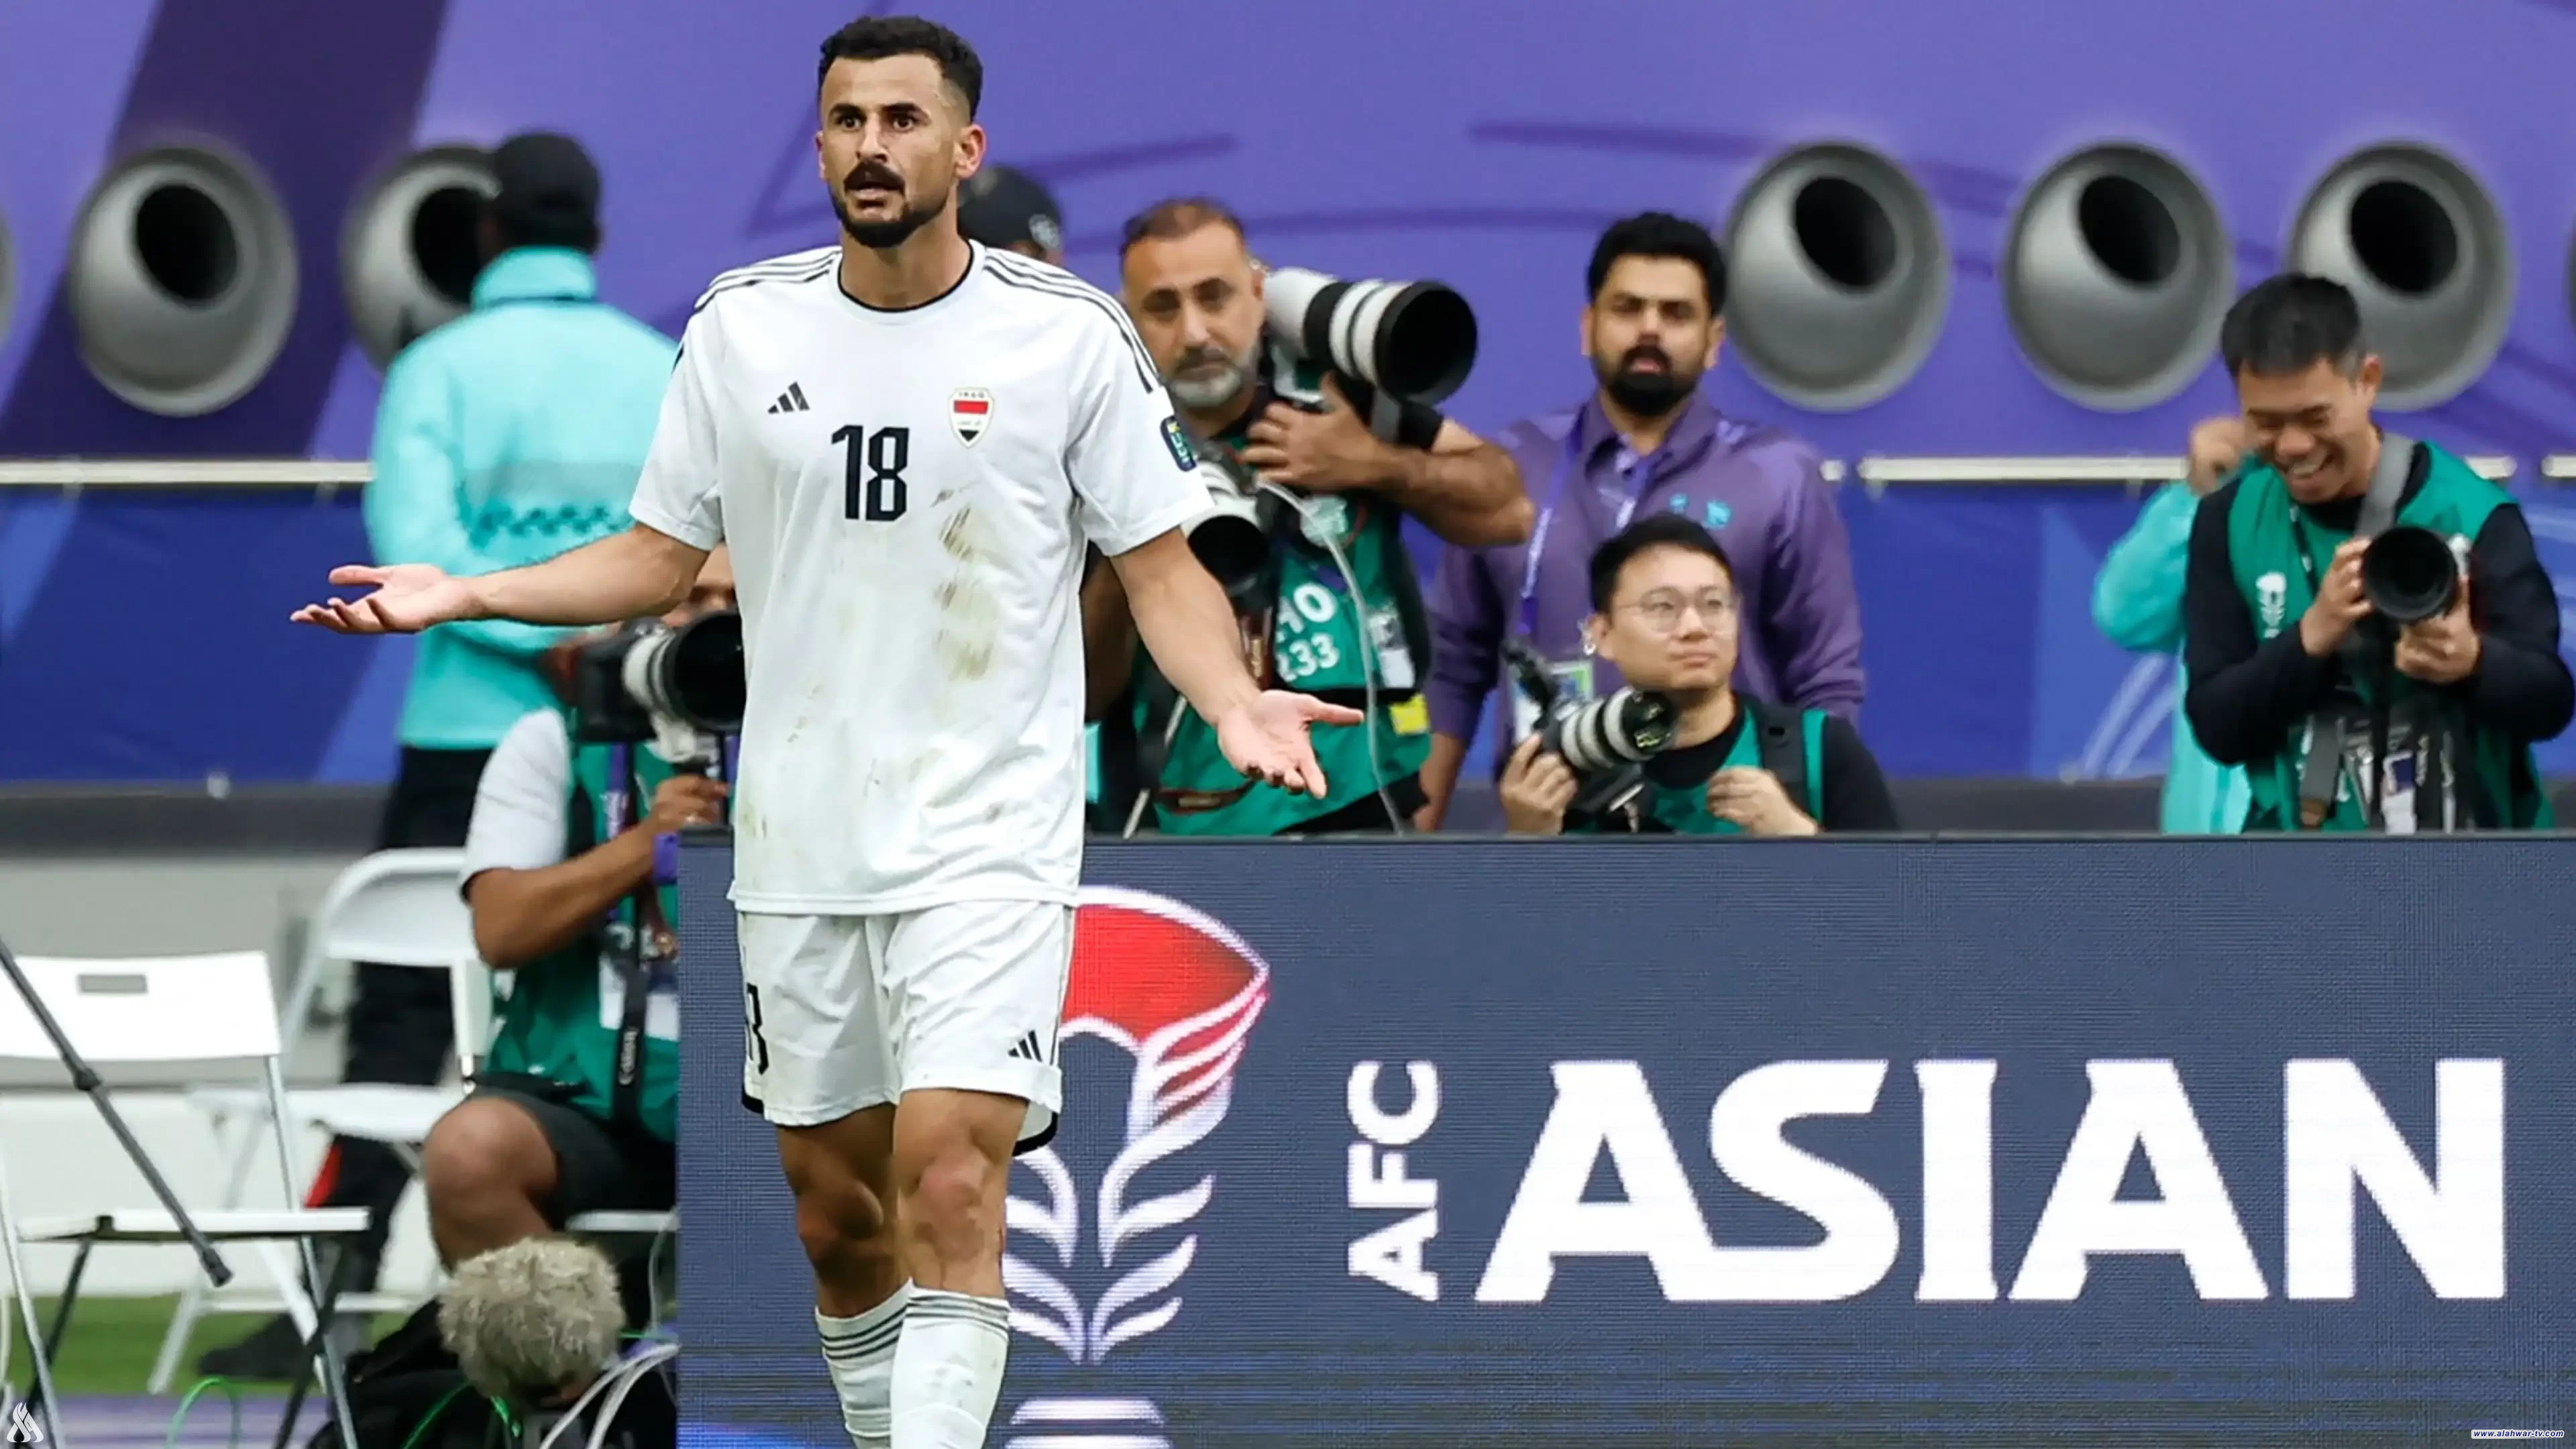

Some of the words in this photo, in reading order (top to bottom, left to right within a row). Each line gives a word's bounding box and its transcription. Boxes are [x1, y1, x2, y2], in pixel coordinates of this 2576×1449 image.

[831, 425, 910, 522] 18
[1347, 1060, 1440, 1302] AFC
[1474, 1058, 2506, 1302] ASIAN
